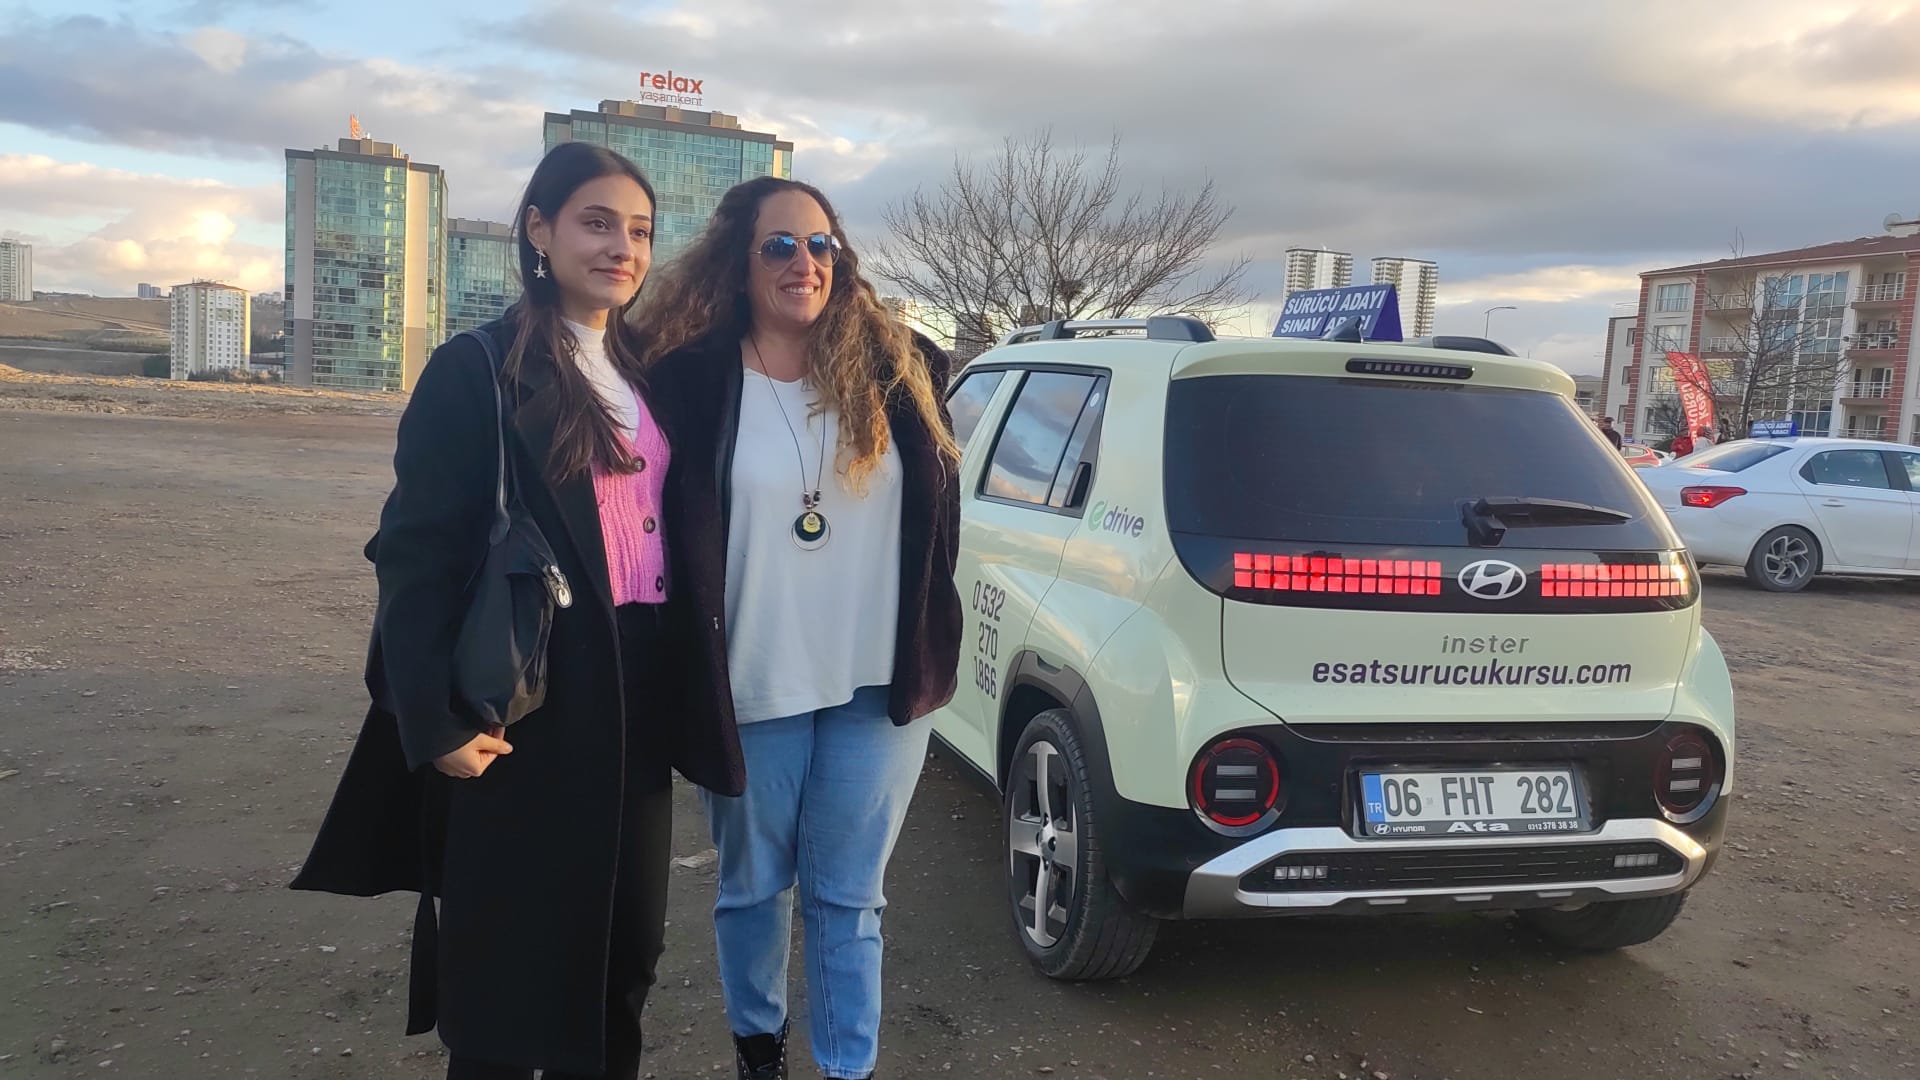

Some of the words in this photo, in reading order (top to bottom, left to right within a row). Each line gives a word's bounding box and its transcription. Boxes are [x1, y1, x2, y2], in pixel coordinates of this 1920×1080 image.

[640, 70, 703, 95] relax
[1285, 290, 1340, 315] SÜRÜCÜ
[1339, 289, 1387, 312] ADAYI
[1280, 316, 1322, 334] SINAV
[978, 621, 998, 661] 270
[1441, 633, 1530, 654] inster
[974, 656, 997, 700] 1866
[1312, 658, 1632, 686] esatsurucukursu.com
[1367, 802, 1383, 814] TR
[1383, 778, 1422, 817] 06
[1440, 776, 1494, 815] FHT
[1517, 776, 1573, 814] 282
[1392, 825, 1426, 833] HYUNDAI
[1446, 821, 1511, 833] Ata
